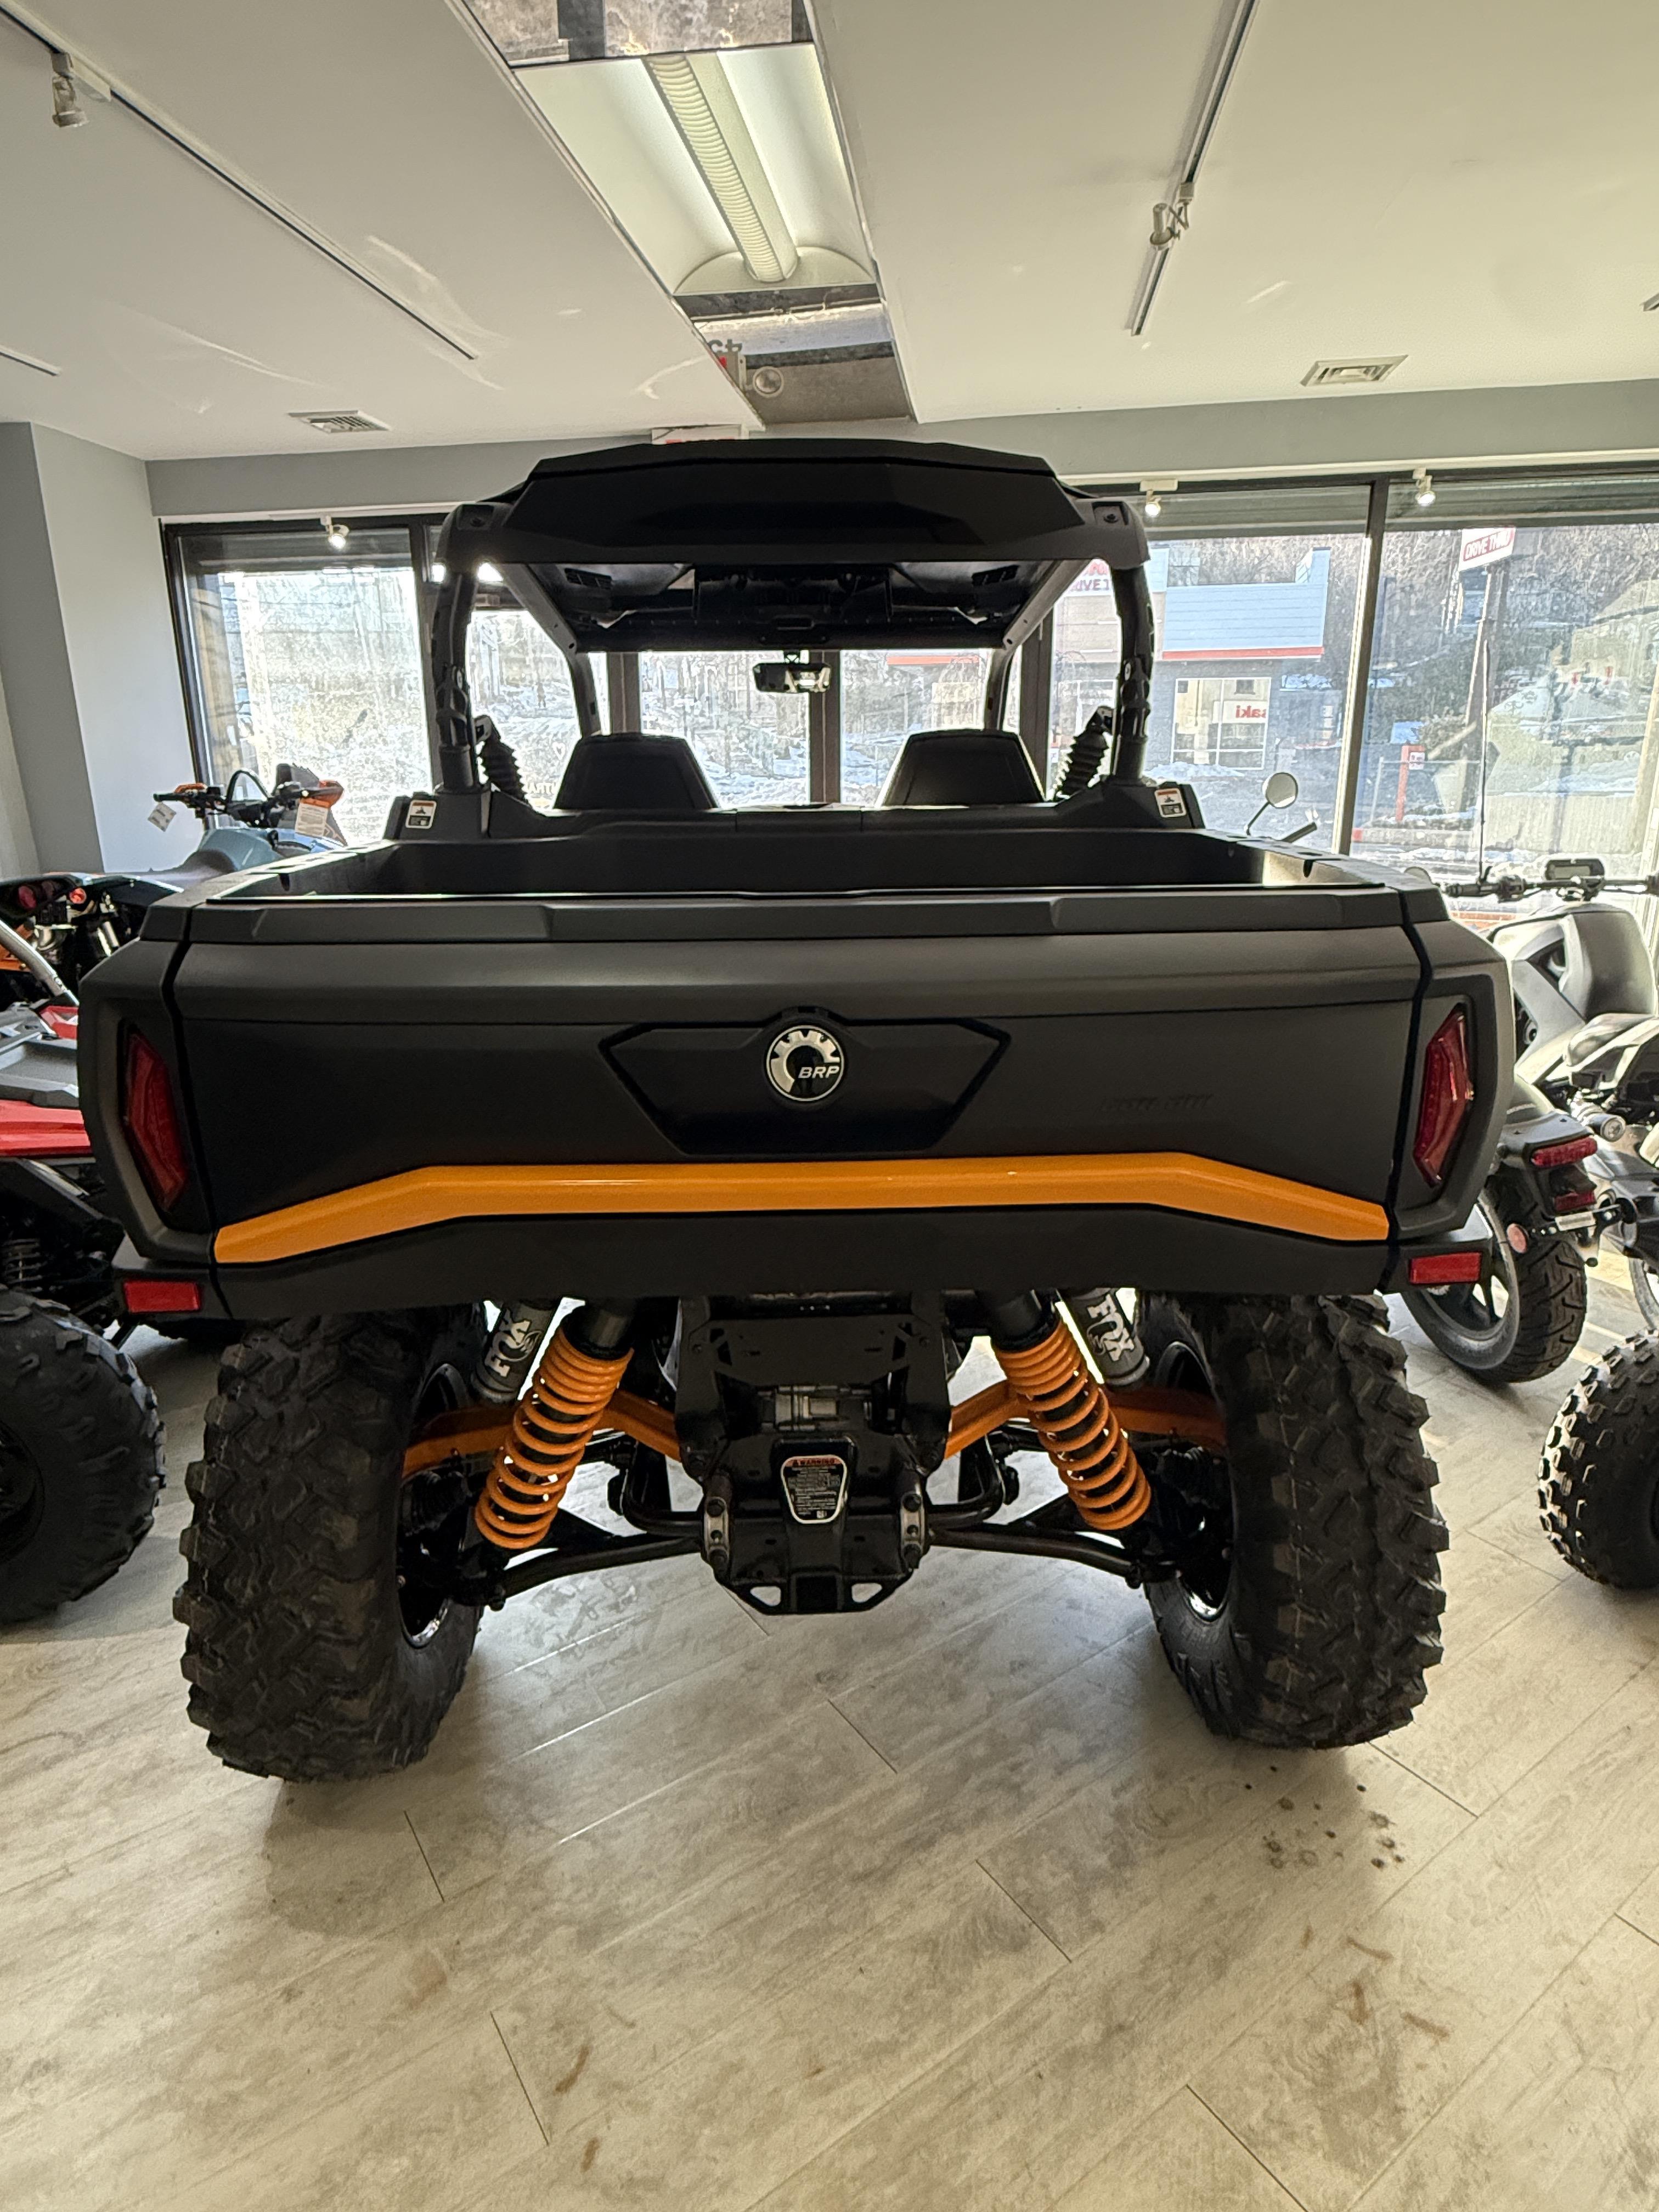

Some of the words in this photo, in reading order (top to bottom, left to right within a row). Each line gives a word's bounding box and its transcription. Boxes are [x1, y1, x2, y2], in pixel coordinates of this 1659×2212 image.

[798, 1066, 839, 1079] BRP
[484, 1308, 538, 1378] FOX
[1087, 1293, 1135, 1362] FOX
